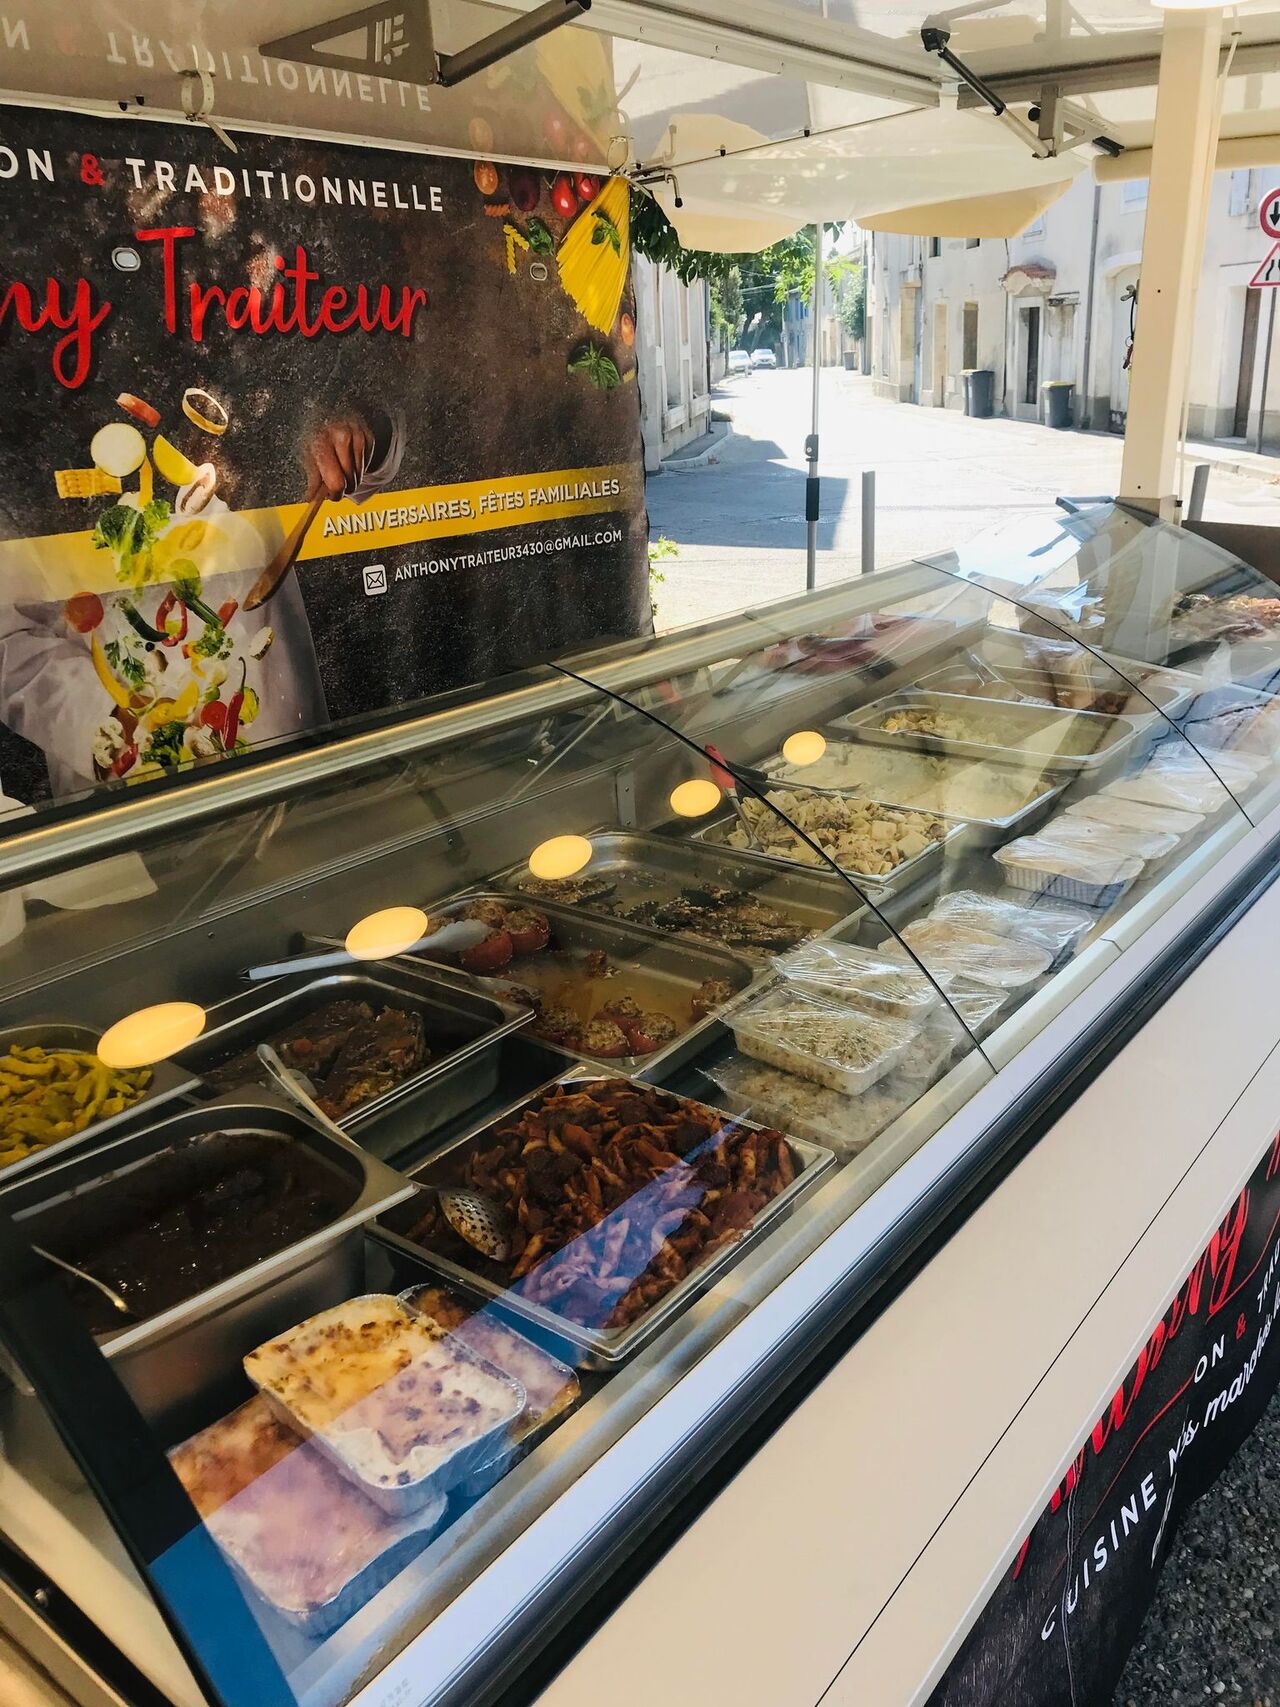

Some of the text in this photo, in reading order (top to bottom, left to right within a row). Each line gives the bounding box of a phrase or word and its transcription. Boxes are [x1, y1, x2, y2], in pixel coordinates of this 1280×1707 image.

[80, 153, 104, 186] &
[125, 158, 443, 212] TRADITIONNELLE
[136, 226, 427, 342] Traiteur
[323, 479, 620, 538] ANNIVERSAIRES, FÊTES FAMILIALES
[394, 529, 622, 583] ANTHONYTRAITEUR3430@GMAIL.COM
[1040, 1471, 1157, 1642] CUISINE
